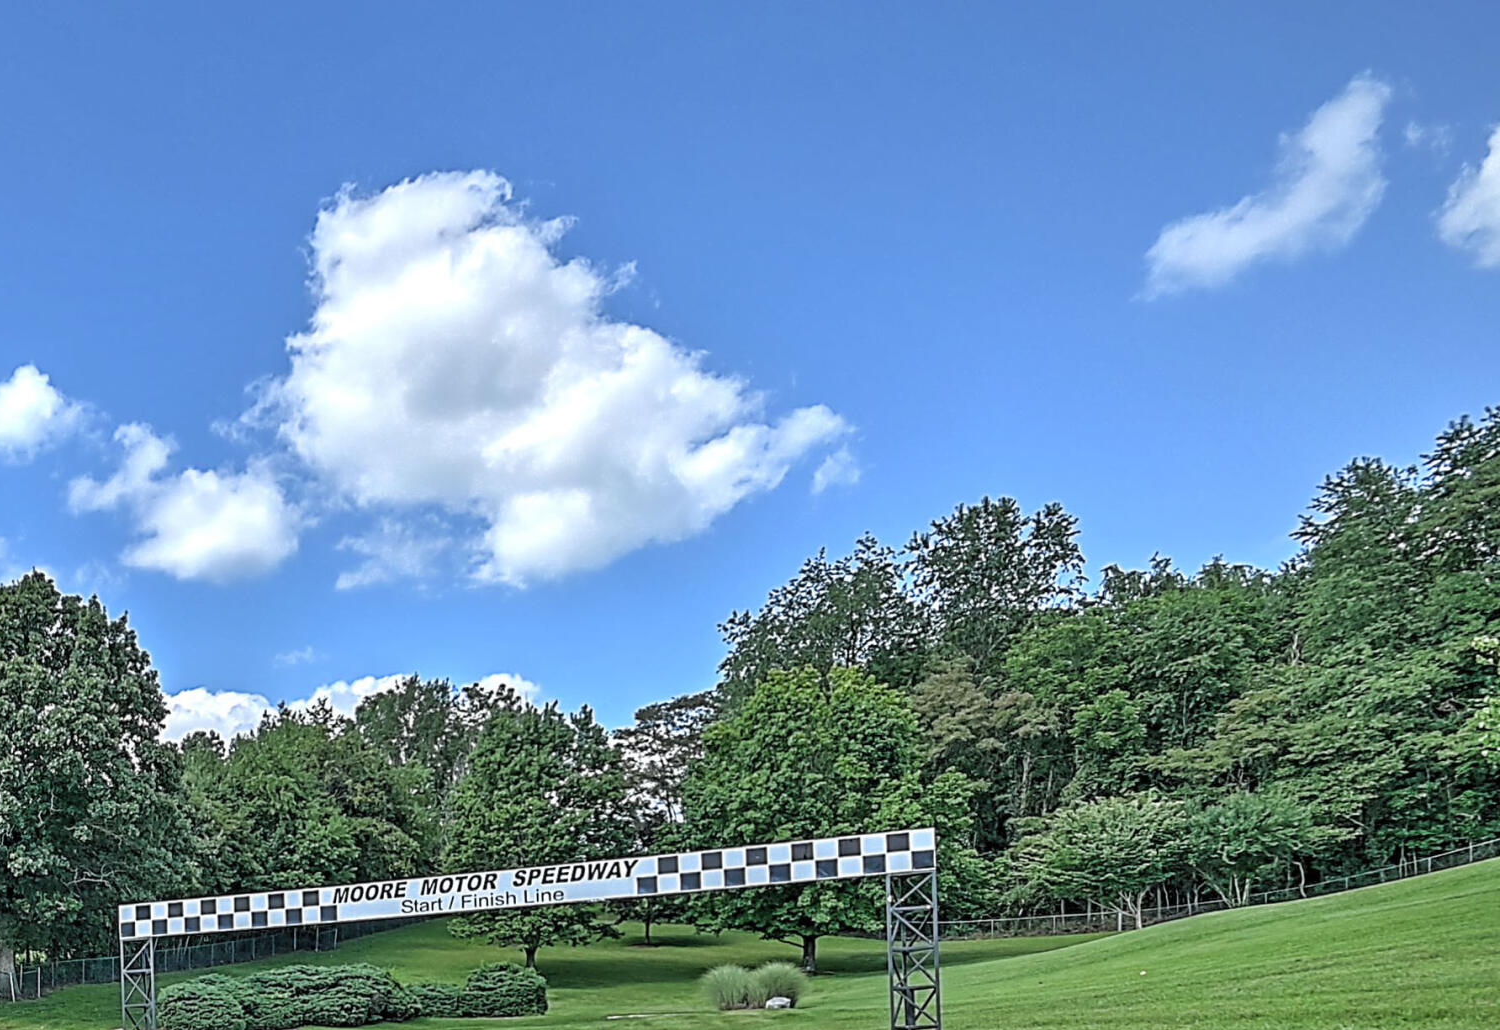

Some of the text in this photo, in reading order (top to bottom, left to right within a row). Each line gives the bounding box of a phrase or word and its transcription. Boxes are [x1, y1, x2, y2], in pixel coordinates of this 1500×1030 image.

[333, 859, 639, 904] MOORE MOTOR SPEEDWAY
[401, 889, 565, 914] Start / Finish Line
